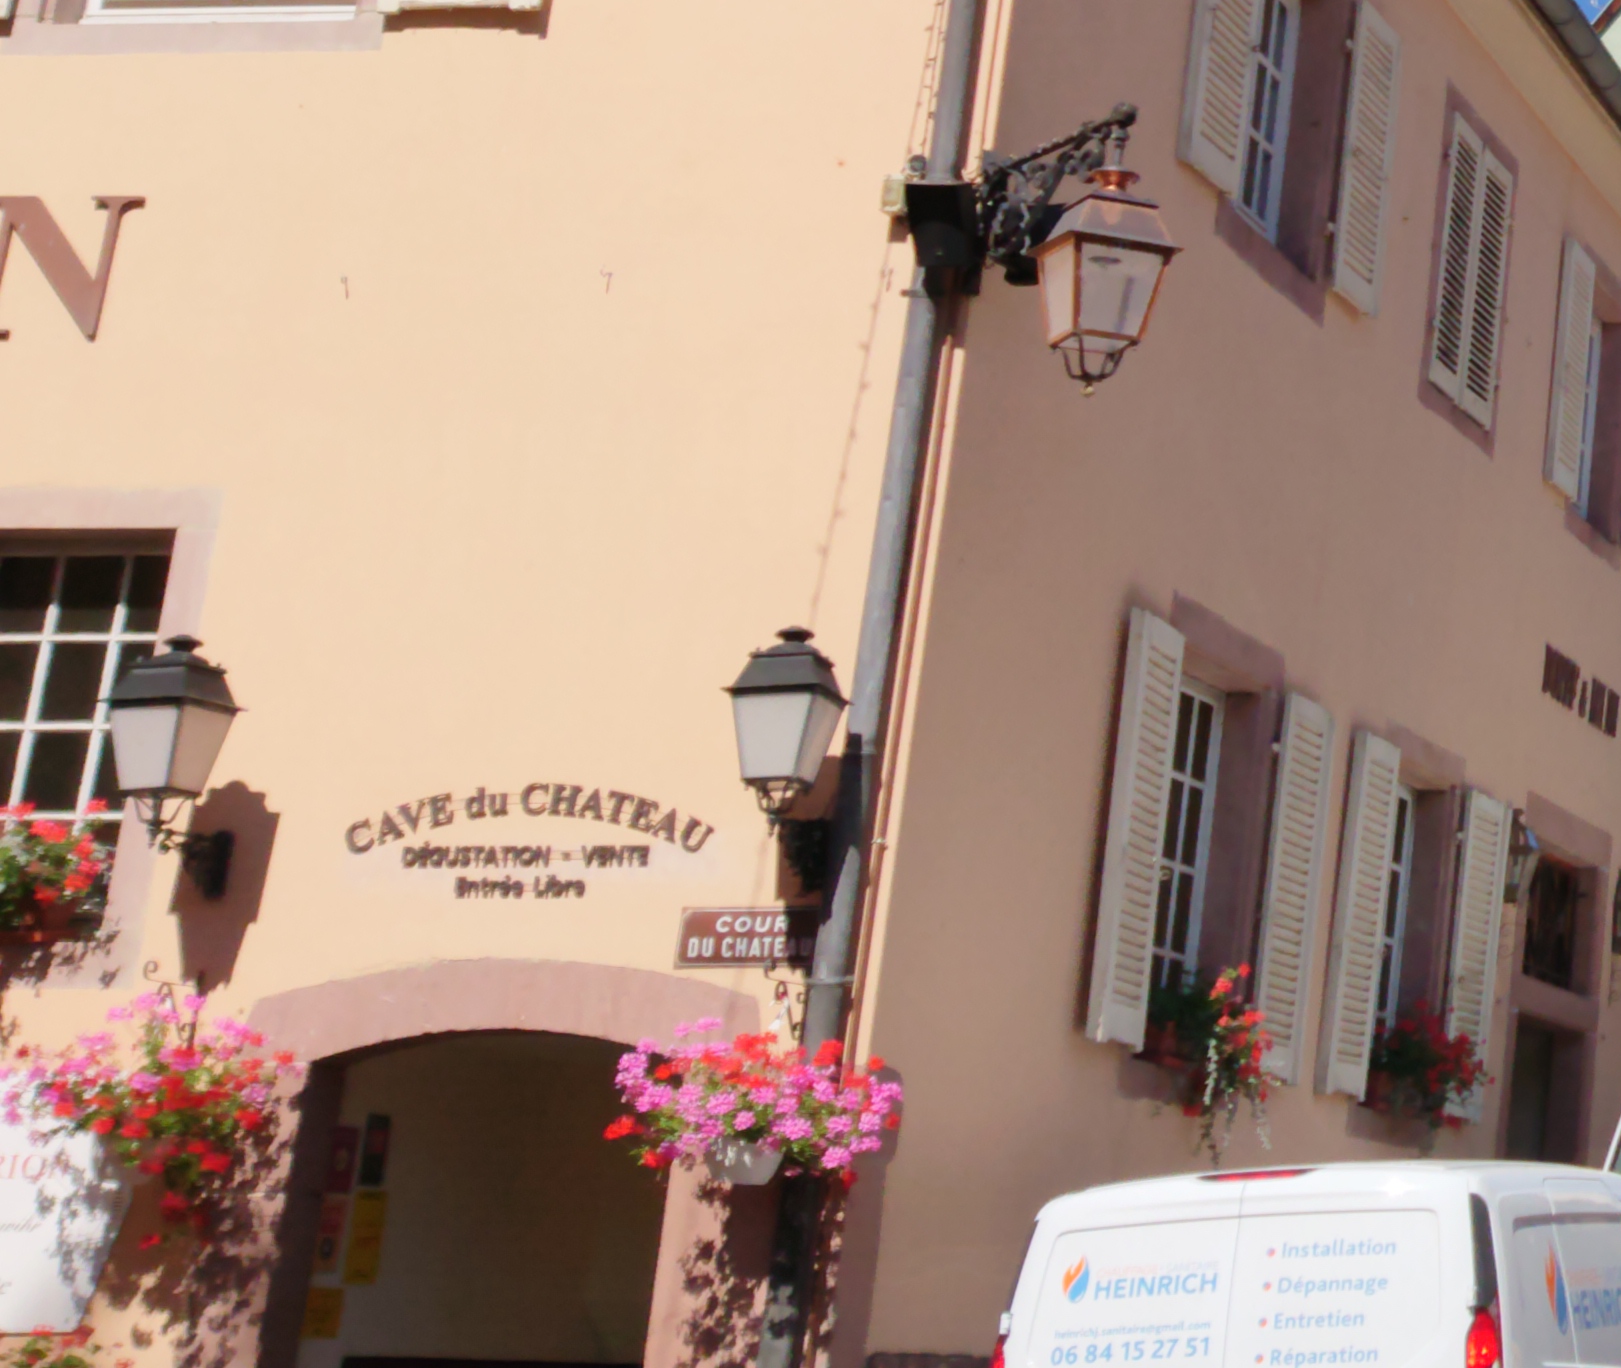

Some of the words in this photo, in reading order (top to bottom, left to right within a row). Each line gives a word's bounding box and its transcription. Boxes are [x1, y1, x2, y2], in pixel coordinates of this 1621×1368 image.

[345, 792, 455, 855] CAVE
[465, 787, 509, 821] du
[520, 782, 715, 854] CHATEAU
[402, 841, 551, 869] DÉGUSTATION
[581, 844, 650, 869] VENTE
[454, 875, 524, 899] Entrée
[532, 875, 586, 899] Libre
[715, 916, 790, 933] COUR
[687, 937, 714, 958] DU
[1282, 1238, 1397, 1258] Installation
[1093, 1272, 1218, 1300] HEINRICH
[1277, 1276, 1389, 1298] Dépannage
[1273, 1309, 1365, 1329] Entretien
[1051, 1346, 1077, 1365] 06
[1084, 1343, 1112, 1363] 84
[1121, 1340, 1145, 1361] 15
[1151, 1338, 1179, 1359] 27
[1184, 1336, 1210, 1358] 51
[1270, 1345, 1379, 1368] Réparation
